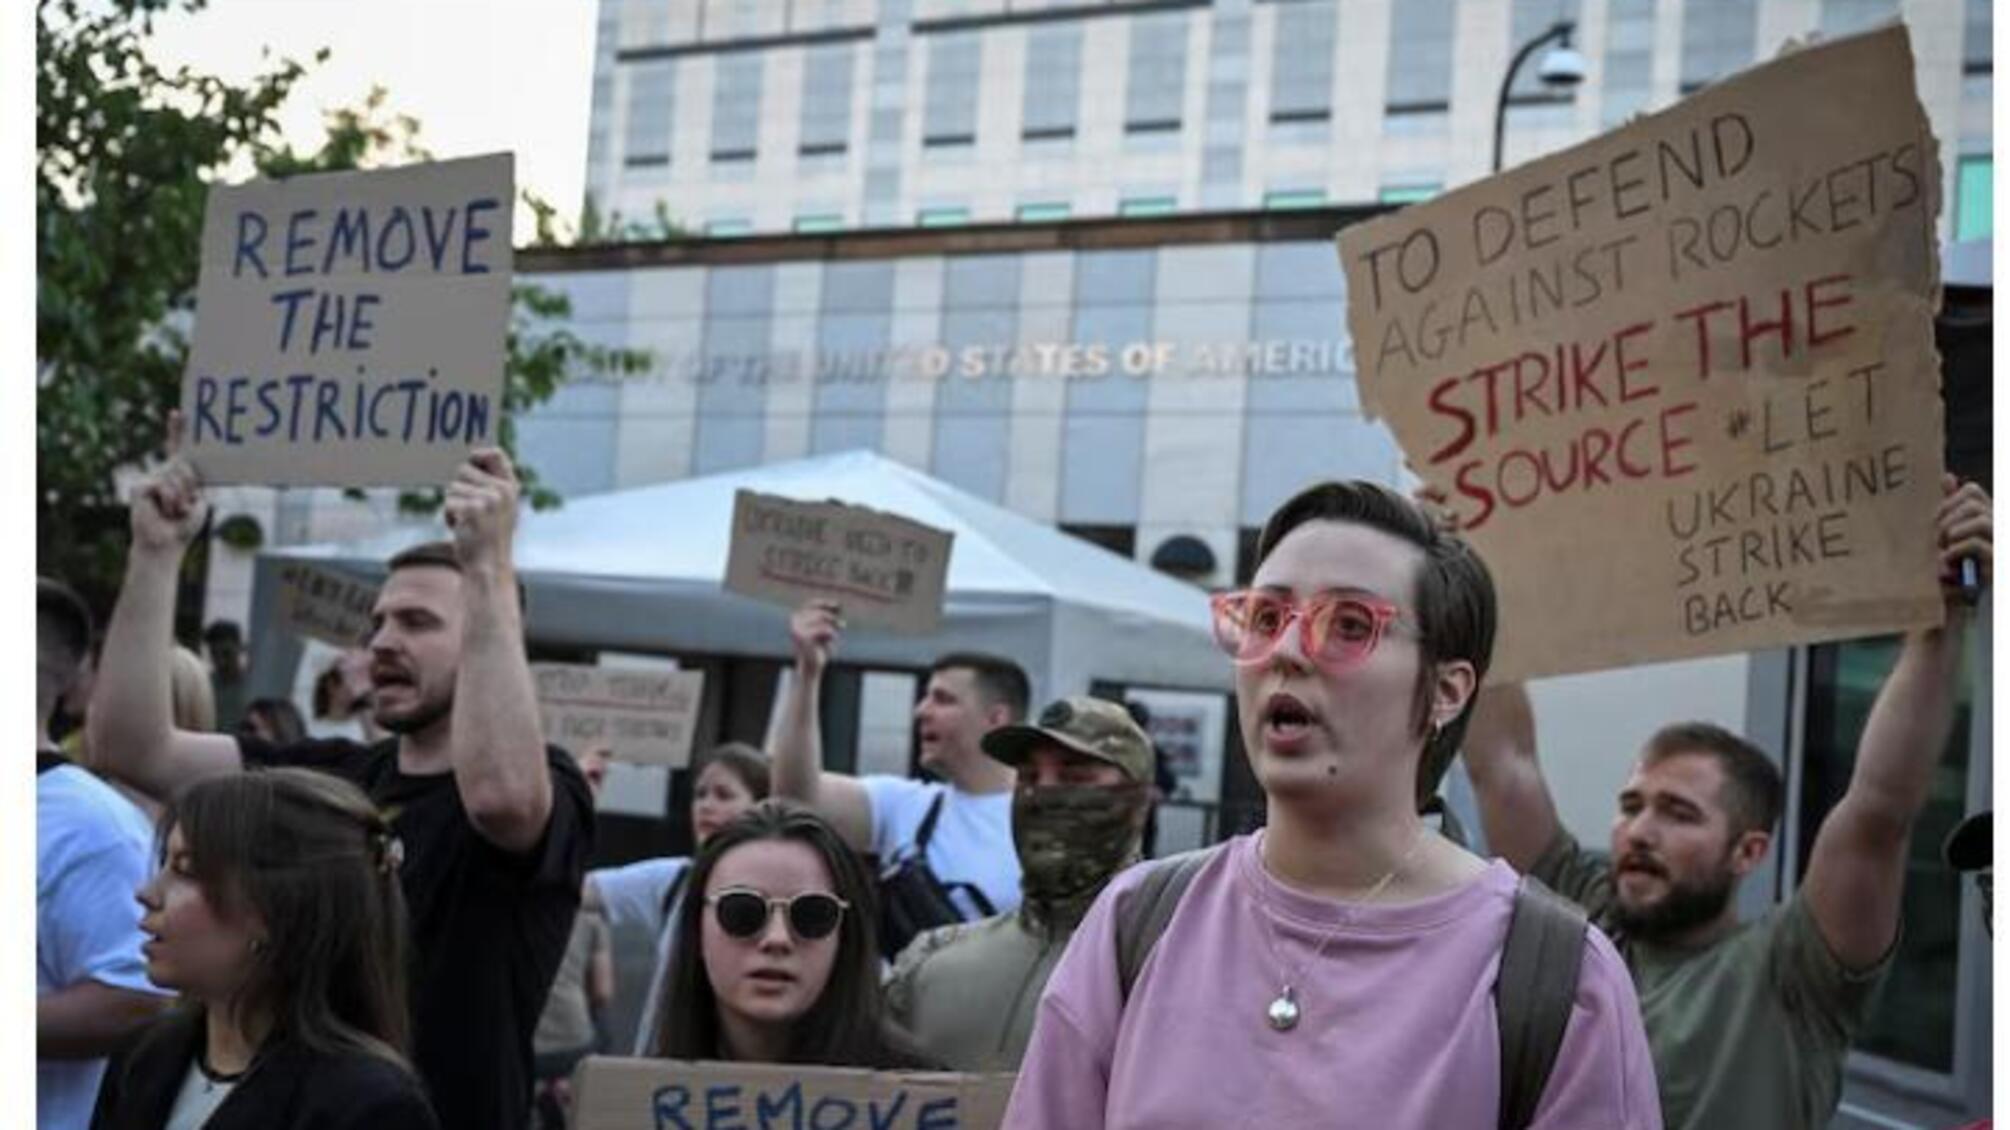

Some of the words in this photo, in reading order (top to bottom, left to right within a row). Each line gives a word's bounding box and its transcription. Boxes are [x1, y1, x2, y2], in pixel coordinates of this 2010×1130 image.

[232, 198, 500, 279] REMOVE
[1359, 226, 1440, 310] TO
[1472, 112, 1755, 267] DEFEND
[1376, 236, 1639, 375] AGAINST
[1667, 143, 1920, 281] ROCKETS
[271, 288, 381, 356] THE
[959, 341, 1110, 378] STATES
[1120, 340, 1175, 376] OF
[1191, 337, 1358, 377] AMERIC
[1426, 321, 1660, 465] STRIKE
[1674, 274, 1857, 381] THE
[1453, 403, 1700, 530] SOURCE
[1667, 444, 1907, 541] UKRAINE
[1677, 512, 1852, 588] STRIKE
[1684, 580, 1794, 637] BACK
[650, 1077, 960, 1130] REMOVE
